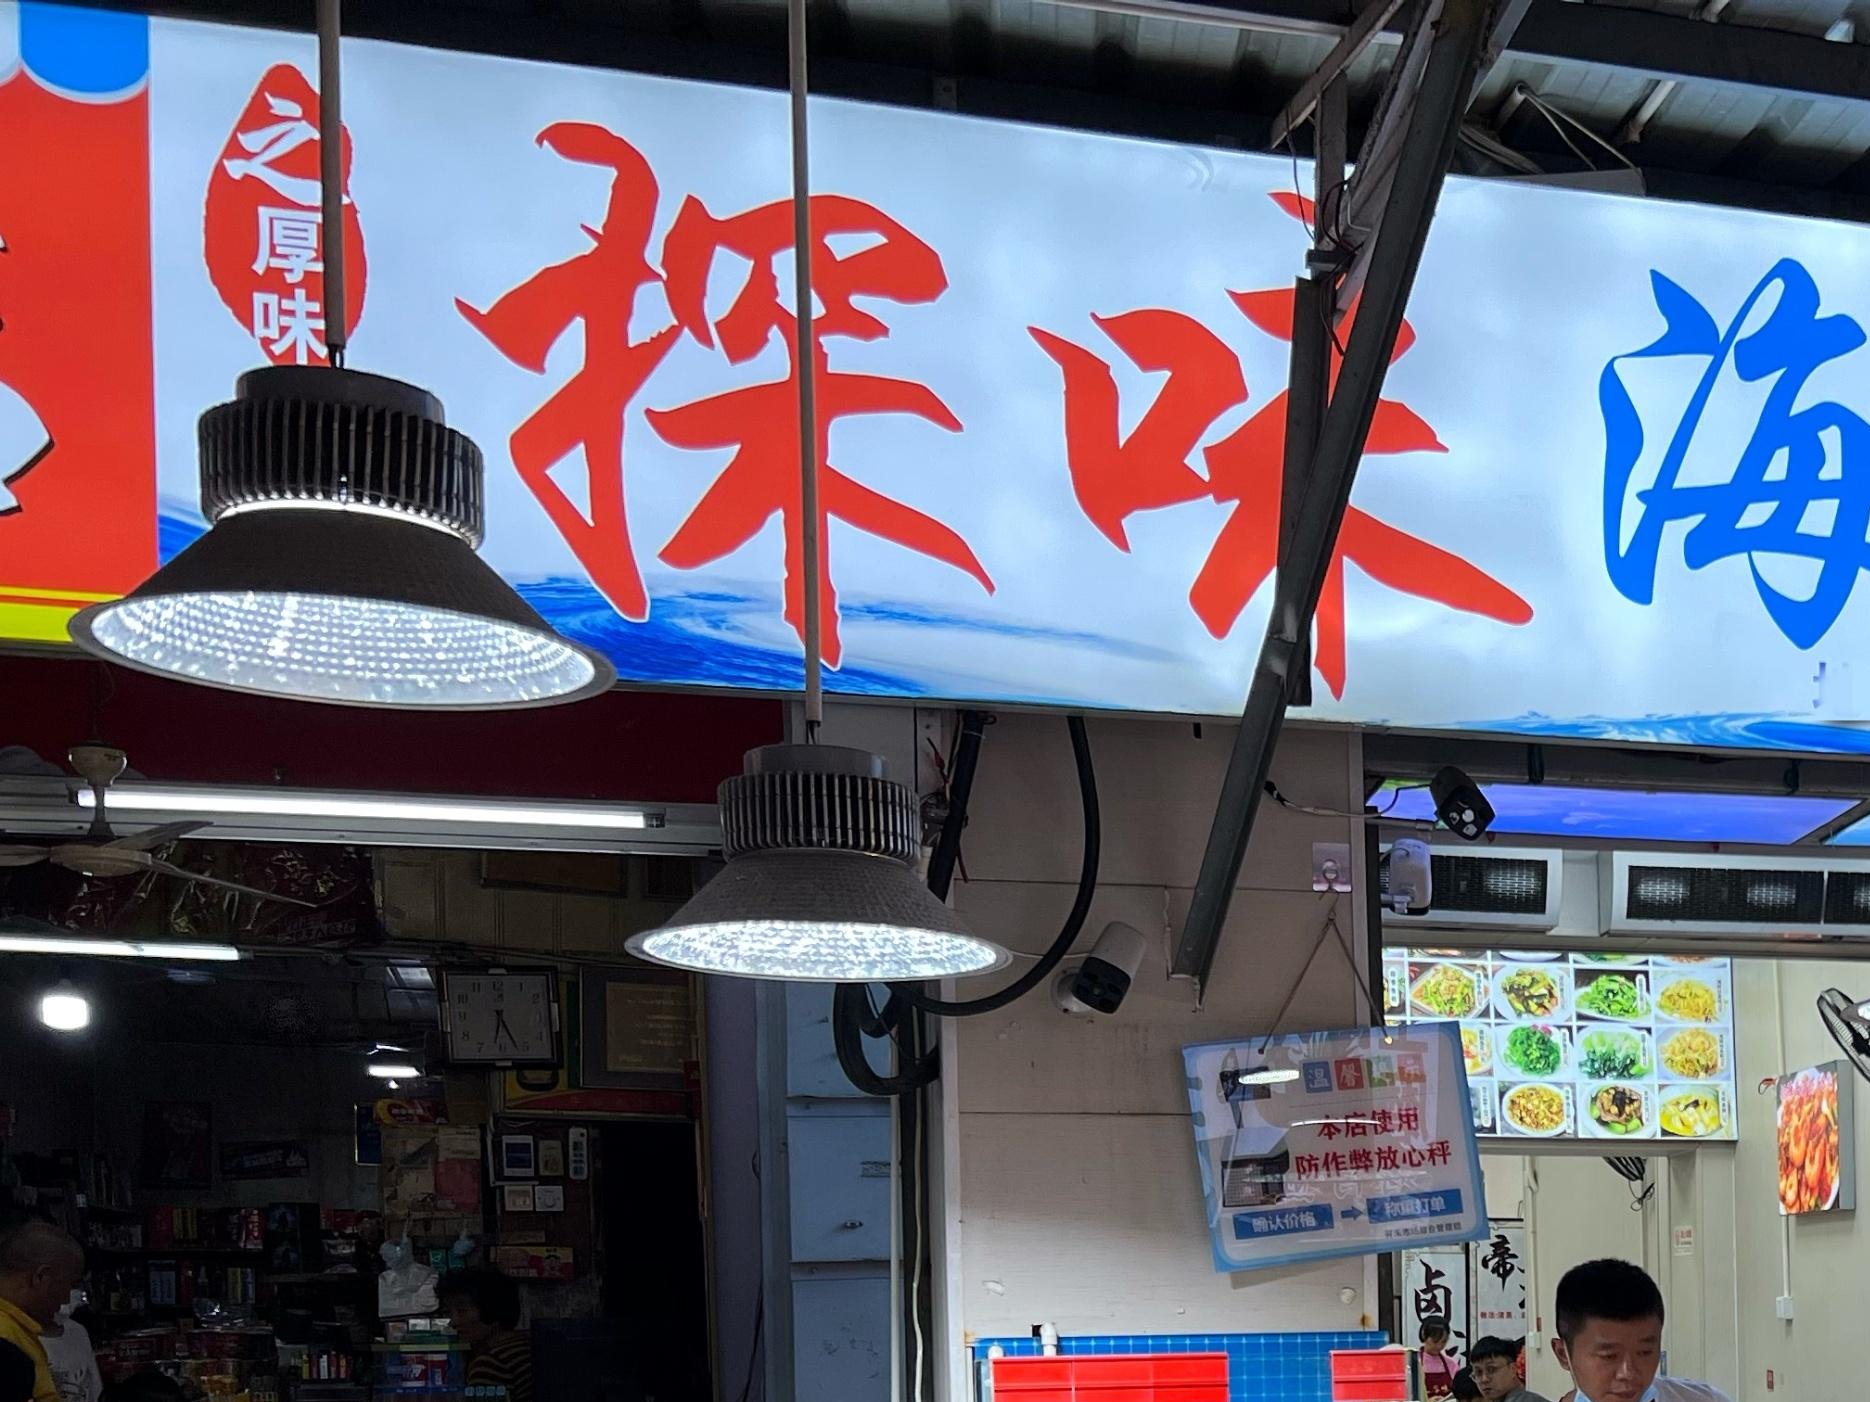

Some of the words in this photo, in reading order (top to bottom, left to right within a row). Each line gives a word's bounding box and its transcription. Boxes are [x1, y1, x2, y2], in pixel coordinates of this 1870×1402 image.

[1317, 1107, 1419, 1141] 本店使用
[1295, 1140, 1452, 1180] 防作弊放心秤
[1252, 1210, 1318, 1234] 确认价格
